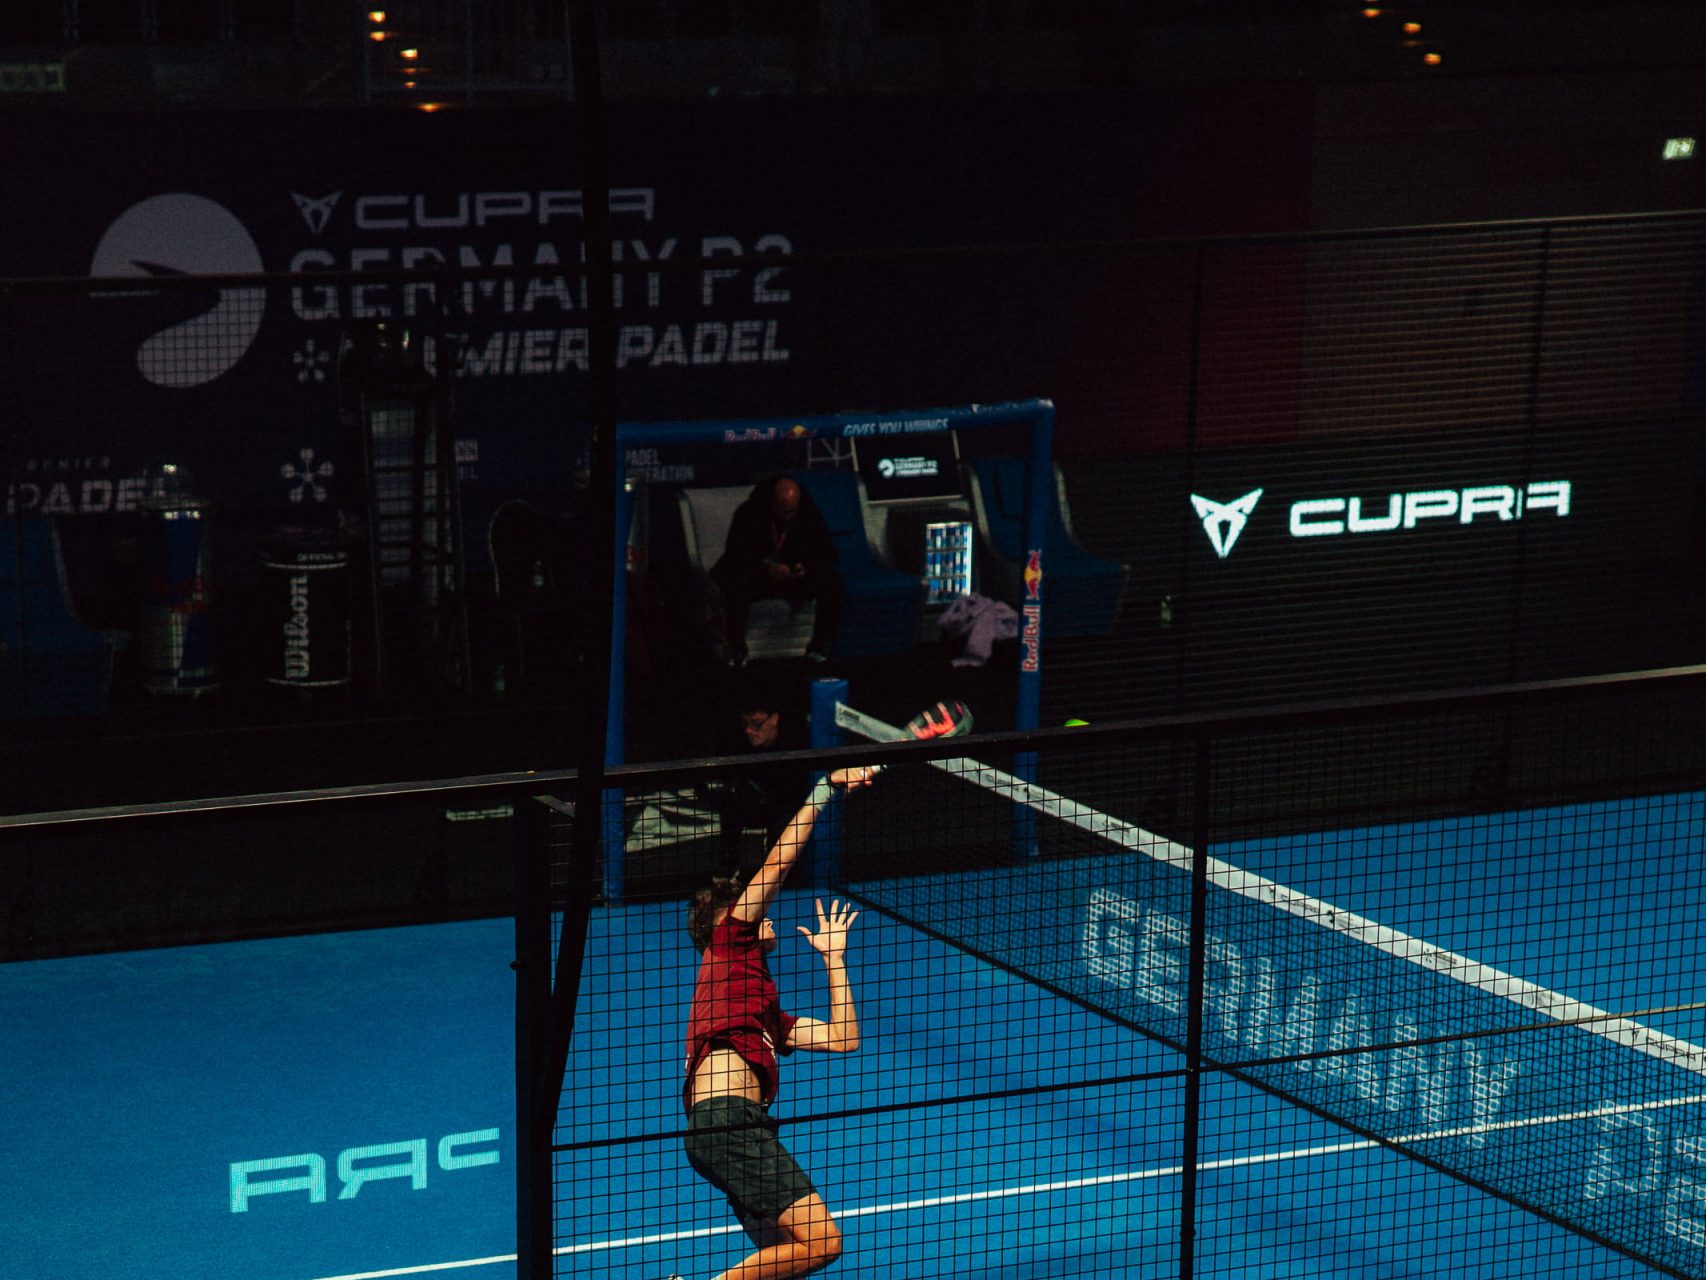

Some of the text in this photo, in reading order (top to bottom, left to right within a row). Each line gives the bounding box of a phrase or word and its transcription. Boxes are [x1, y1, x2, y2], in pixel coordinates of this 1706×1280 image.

[354, 186, 655, 231] CUPRA
[701, 233, 793, 307] P2
[615, 319, 791, 369] PADEL
[1289, 480, 1572, 537] CUPRA
[283, 575, 311, 680] Wilson
